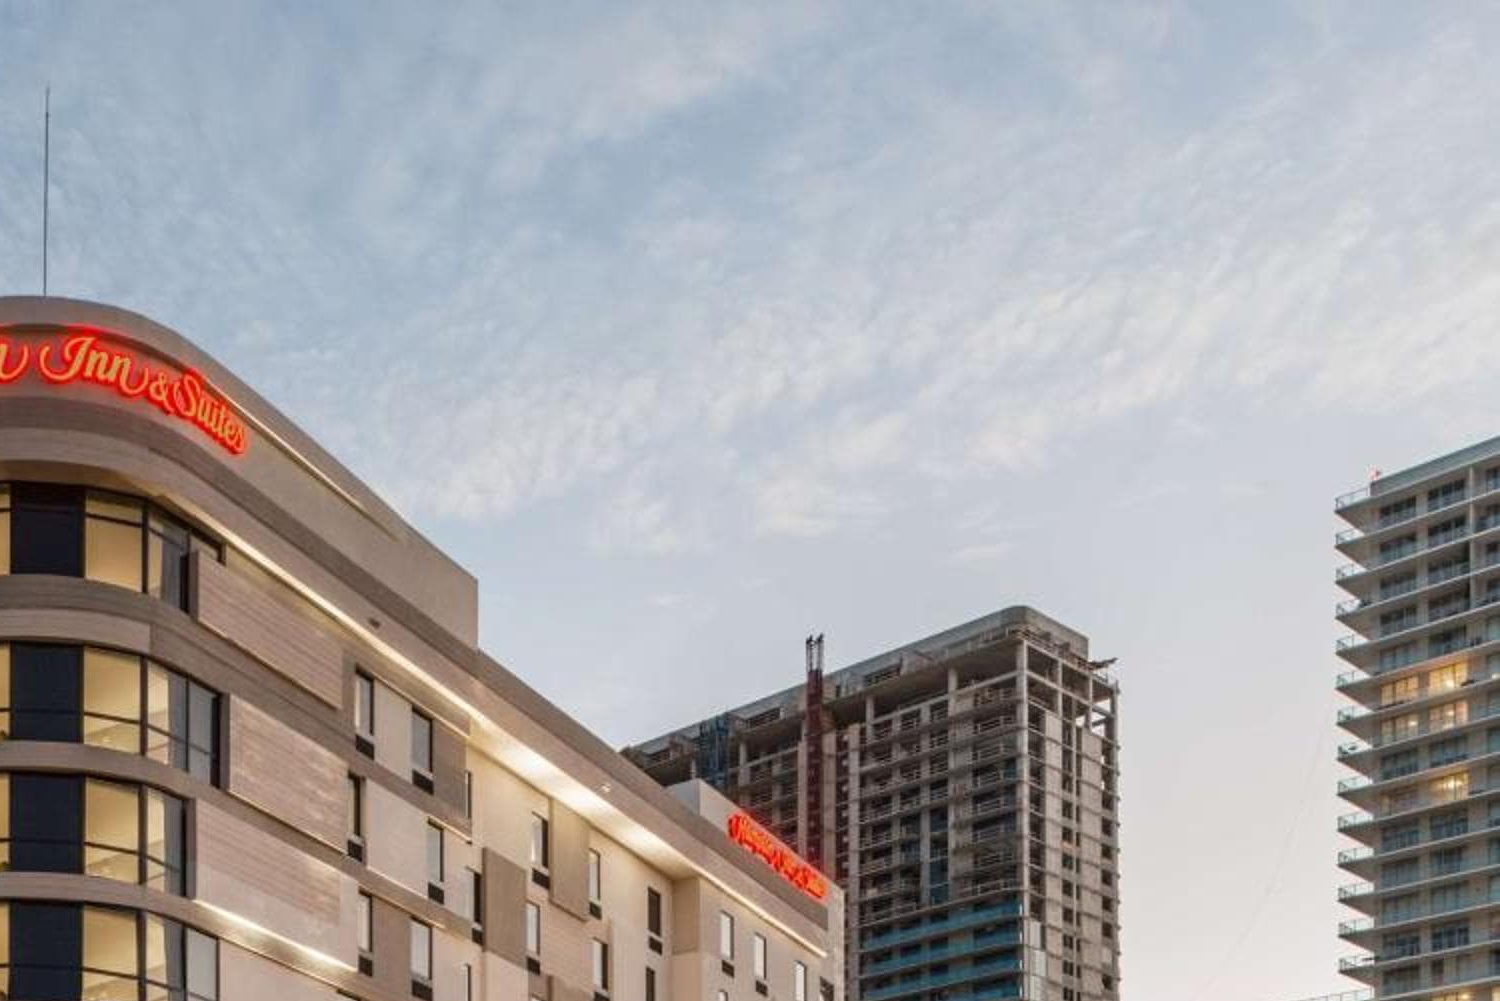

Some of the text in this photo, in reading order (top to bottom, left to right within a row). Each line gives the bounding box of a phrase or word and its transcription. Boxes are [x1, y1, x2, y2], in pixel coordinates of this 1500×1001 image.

[39, 336, 149, 396] Inn
[149, 371, 175, 415] &
[173, 373, 246, 452] Suites
